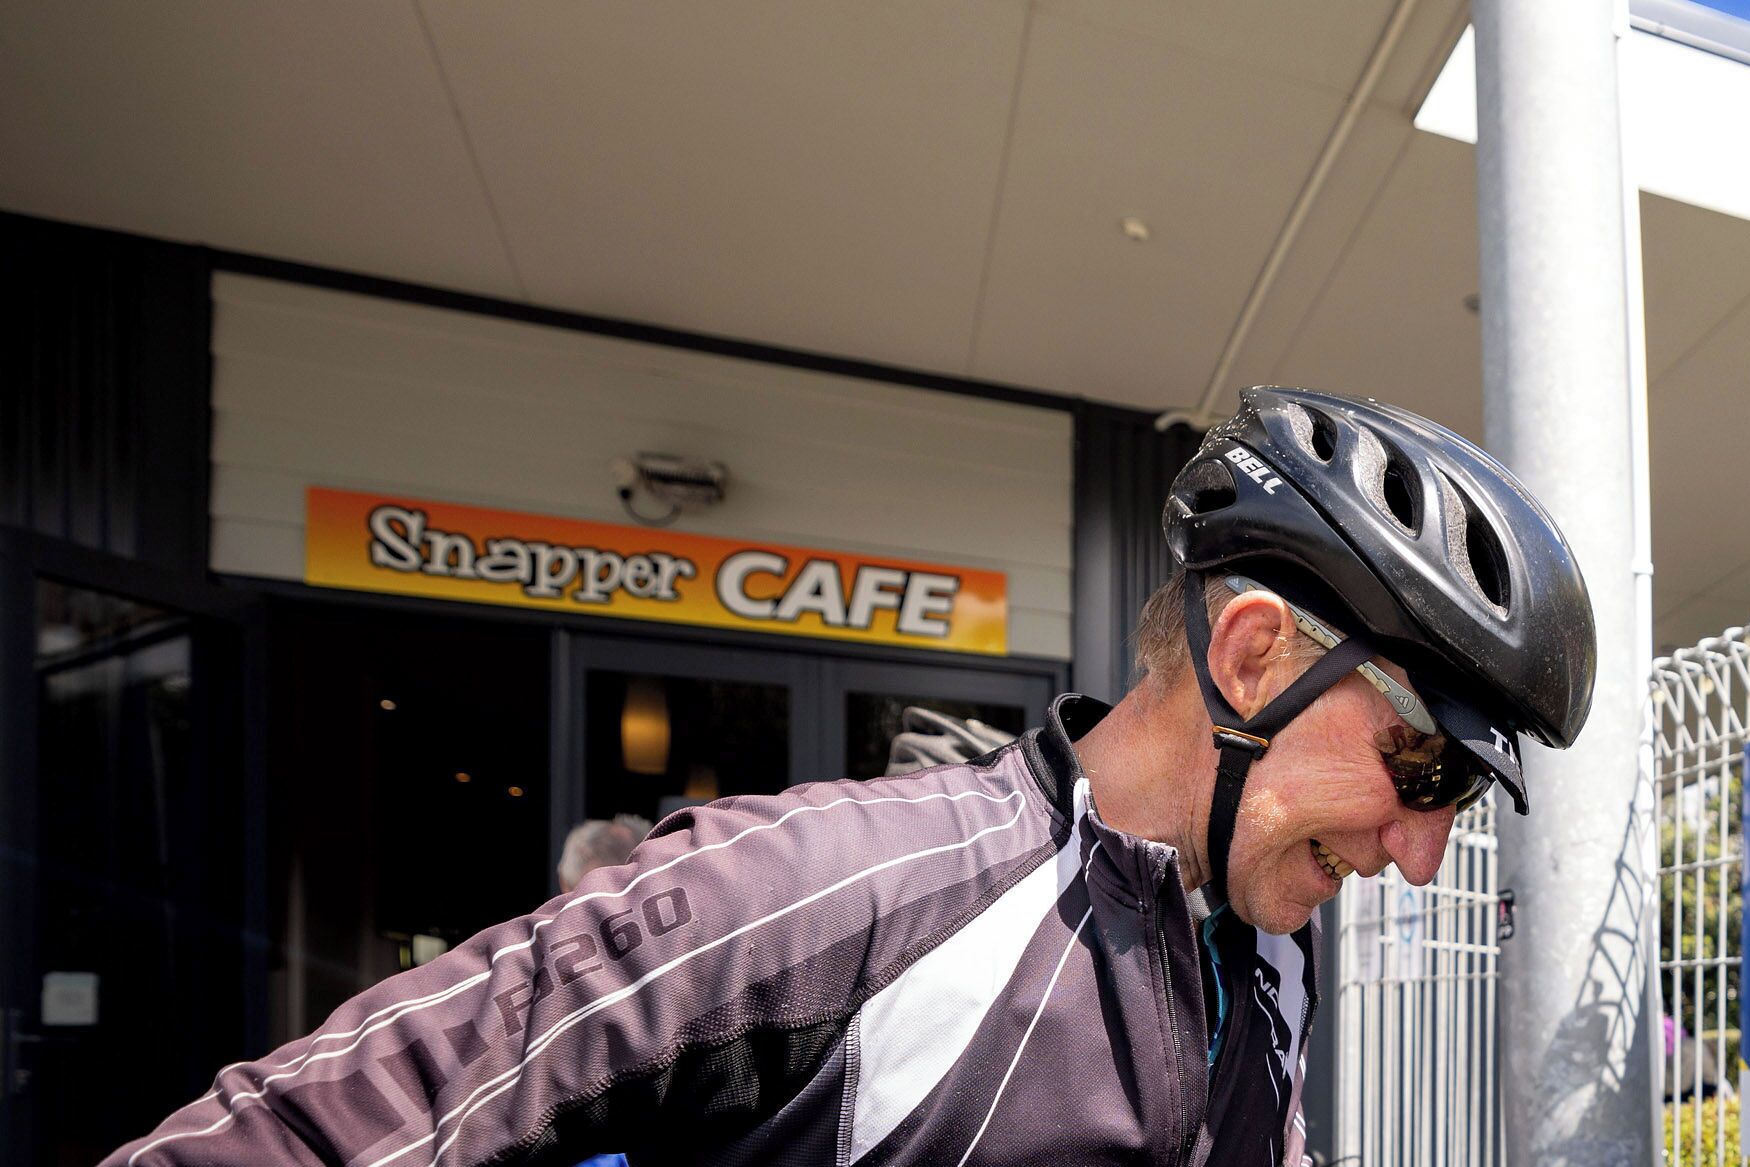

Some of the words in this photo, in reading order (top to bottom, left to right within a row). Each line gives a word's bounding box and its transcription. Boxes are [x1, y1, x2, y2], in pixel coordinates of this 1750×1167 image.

[1224, 446, 1283, 496] BELL
[368, 506, 696, 604] Snapper
[714, 549, 959, 639] CAFE
